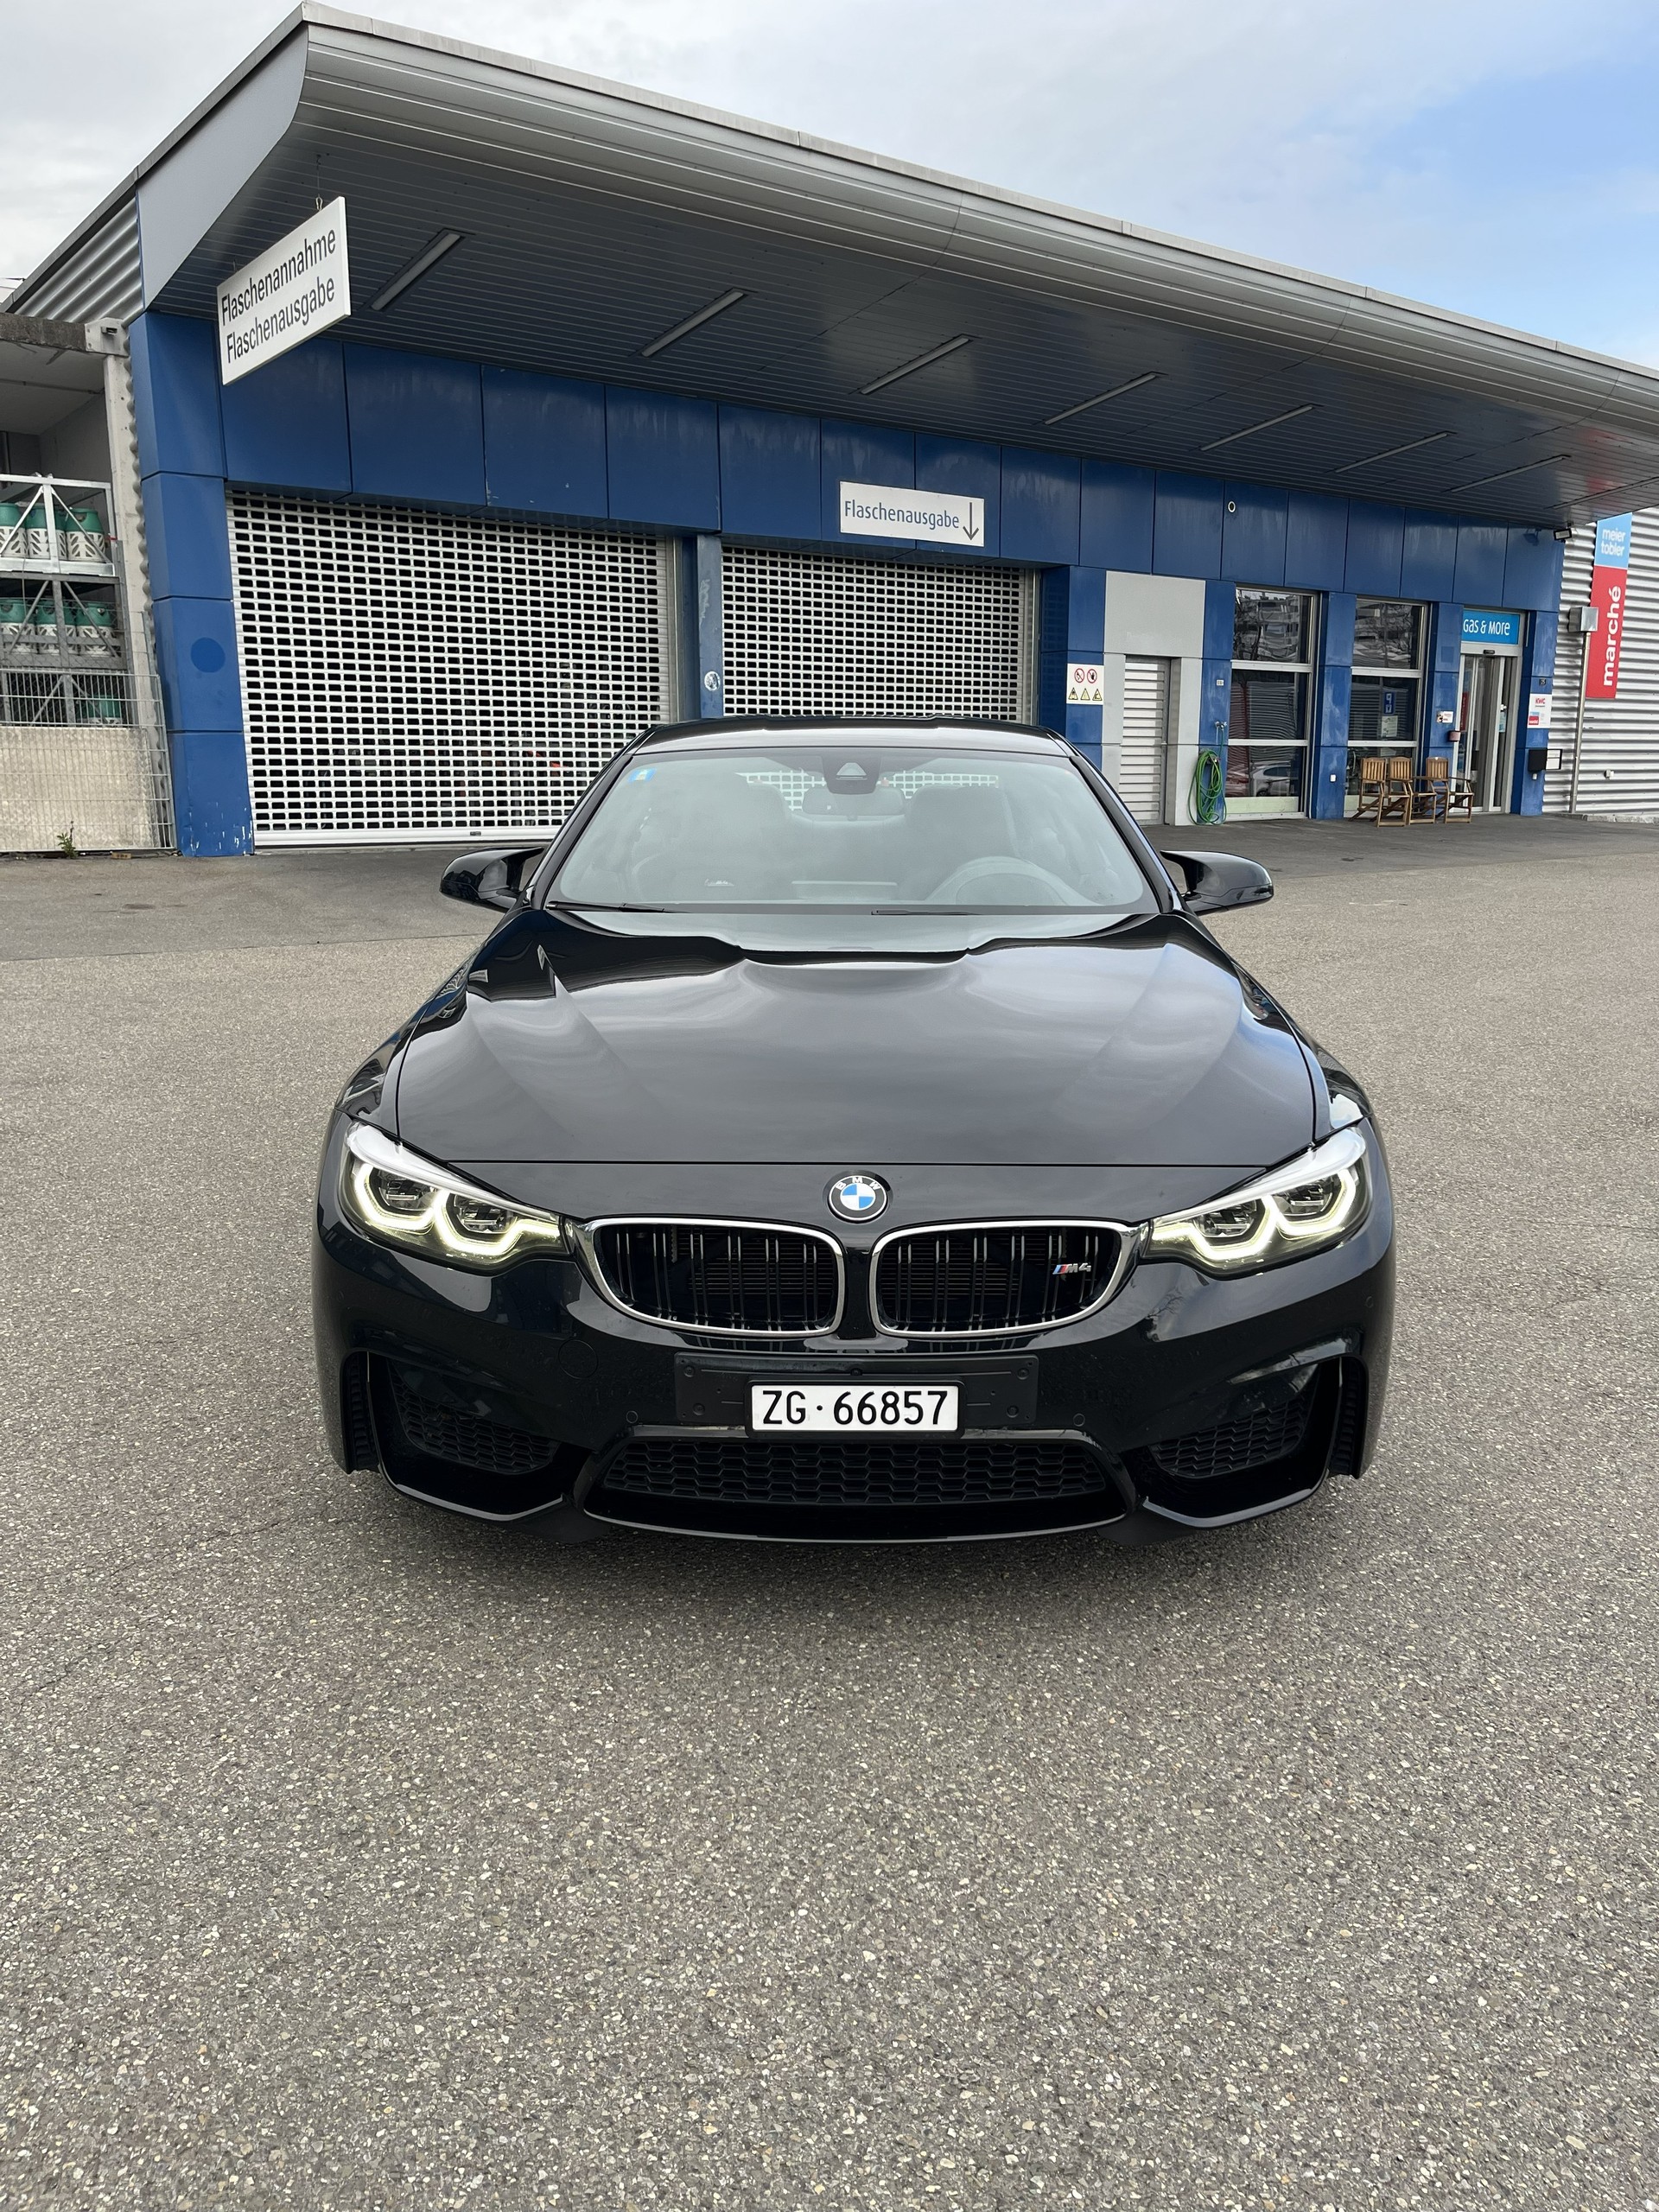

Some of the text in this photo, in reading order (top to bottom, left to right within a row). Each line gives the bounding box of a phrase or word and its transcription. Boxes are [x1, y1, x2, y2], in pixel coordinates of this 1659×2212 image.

[221, 229, 336, 327] Flaschenannahme
[226, 276, 335, 364] Flaschenausgabe
[844, 499, 960, 531] Flaschenausgabe
[1602, 527, 1626, 543] meier
[1600, 539, 1625, 557] tobler
[1480, 620, 1486, 634] &
[1603, 586, 1622, 686] marché
[835, 1176, 881, 1190] BMW
[1064, 1262, 1091, 1274] M4
